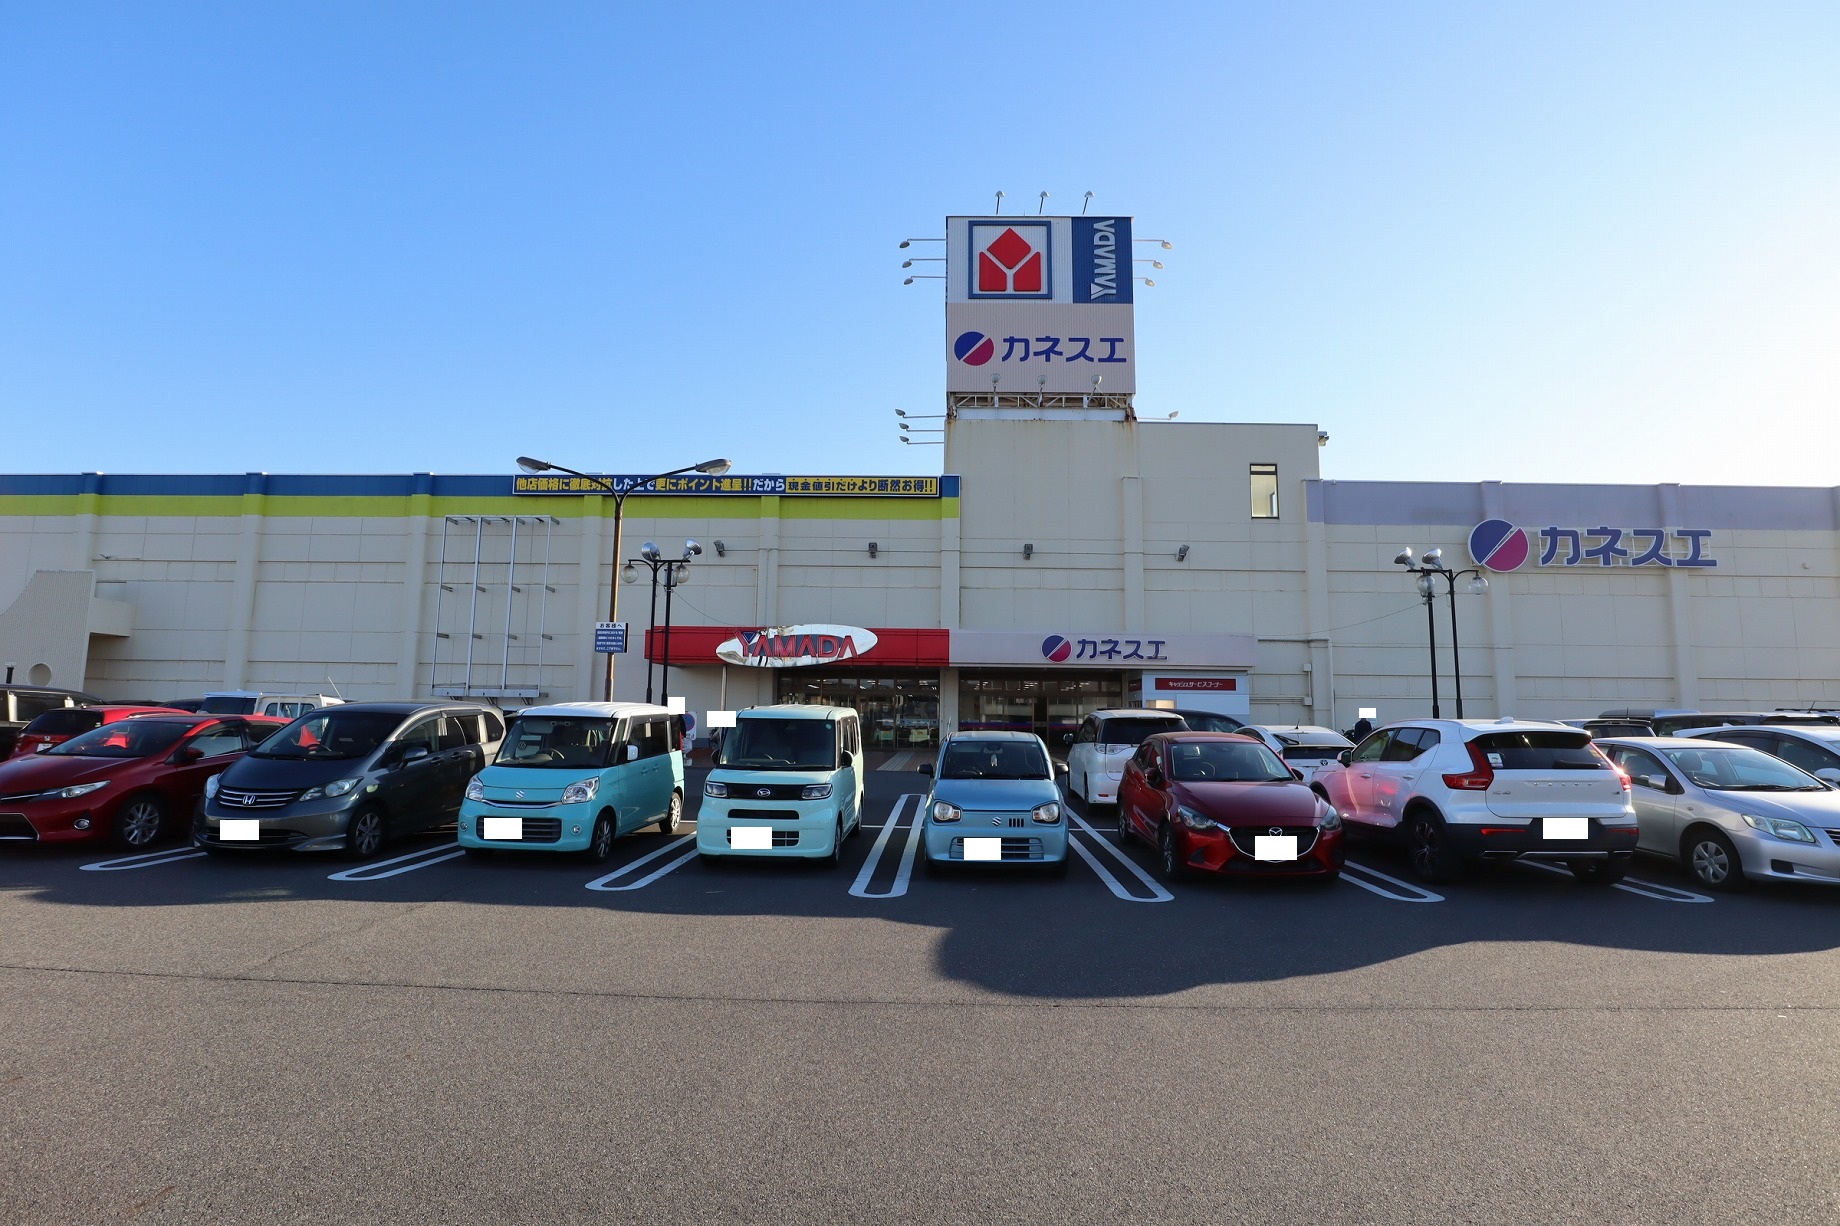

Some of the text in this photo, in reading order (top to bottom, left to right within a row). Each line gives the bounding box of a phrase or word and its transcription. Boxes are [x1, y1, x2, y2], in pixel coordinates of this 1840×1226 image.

[1090, 219, 1117, 300] YAMADA
[1001, 335, 1127, 362] カネスエ
[1540, 526, 1718, 567] カネスエ
[733, 630, 858, 658] YAMADA
[1076, 638, 1168, 660] カネスエ
